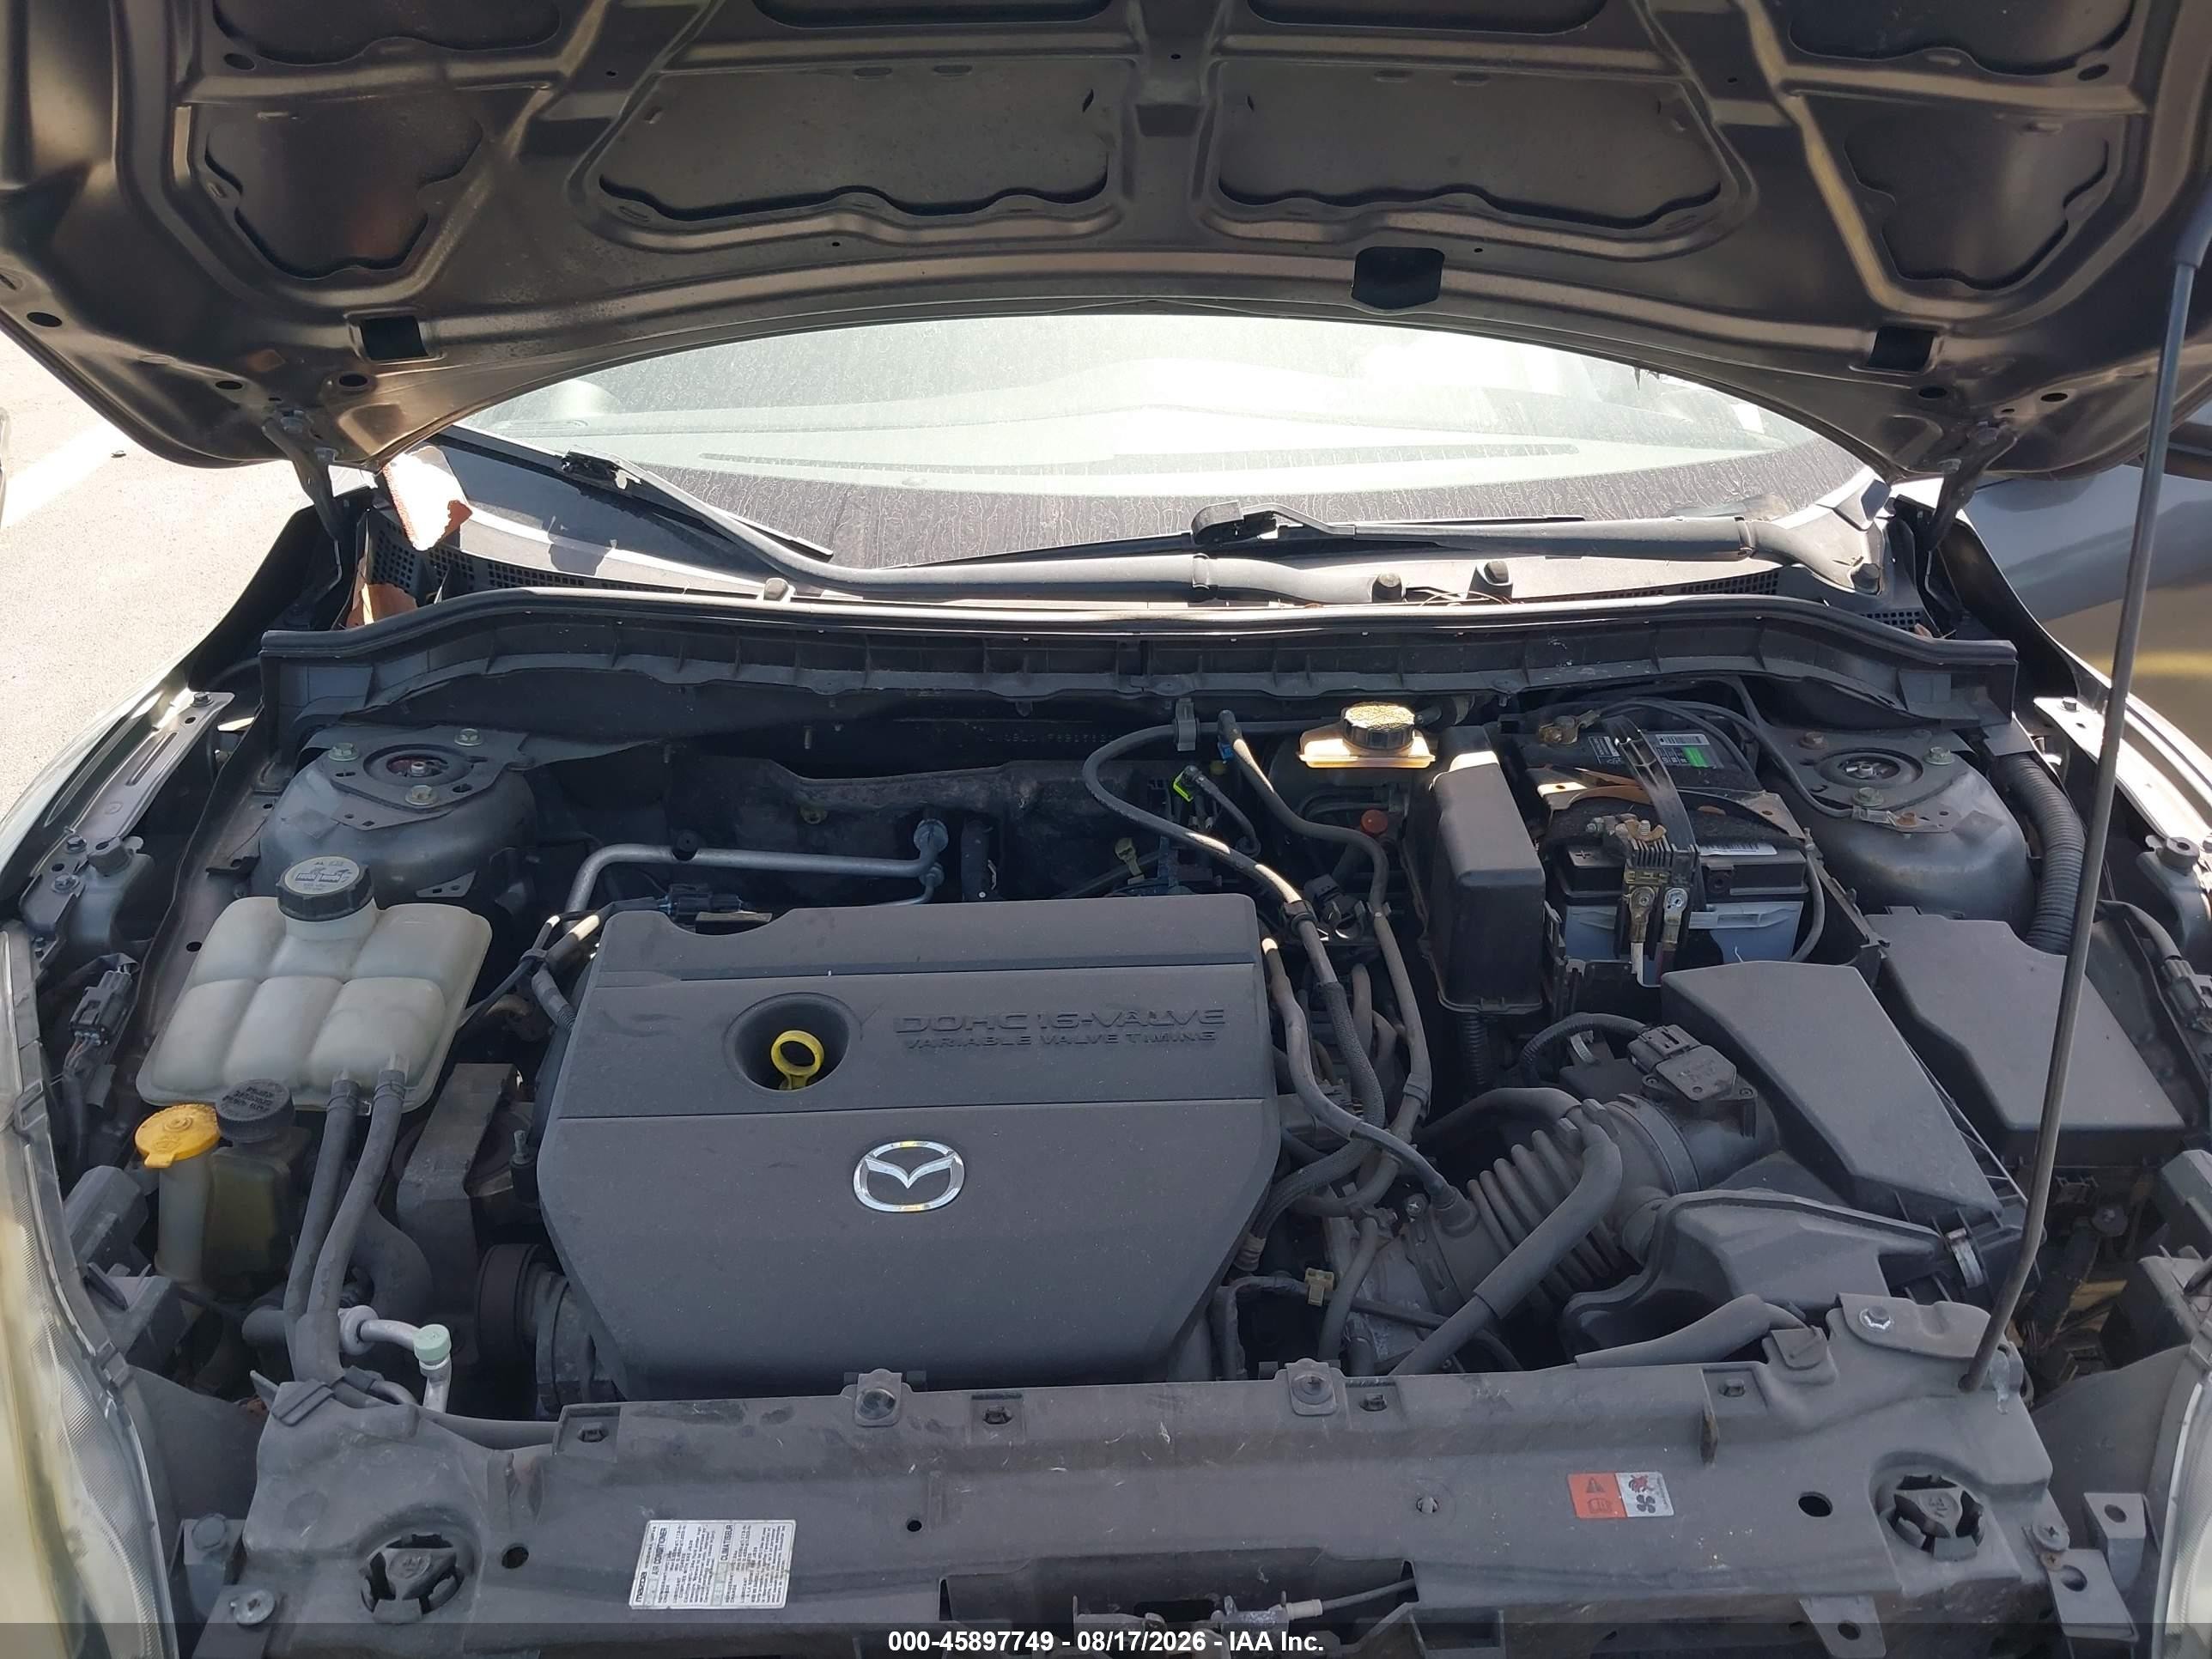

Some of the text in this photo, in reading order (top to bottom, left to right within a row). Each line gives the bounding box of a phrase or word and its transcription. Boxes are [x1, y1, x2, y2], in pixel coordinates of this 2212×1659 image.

[894, 1013, 1029, 1034] DOHC
[905, 1036, 1032, 1049] VARIABLE
[1040, 1034, 1120, 1044] VALVE
[635, 1571, 648, 1602] mazda
